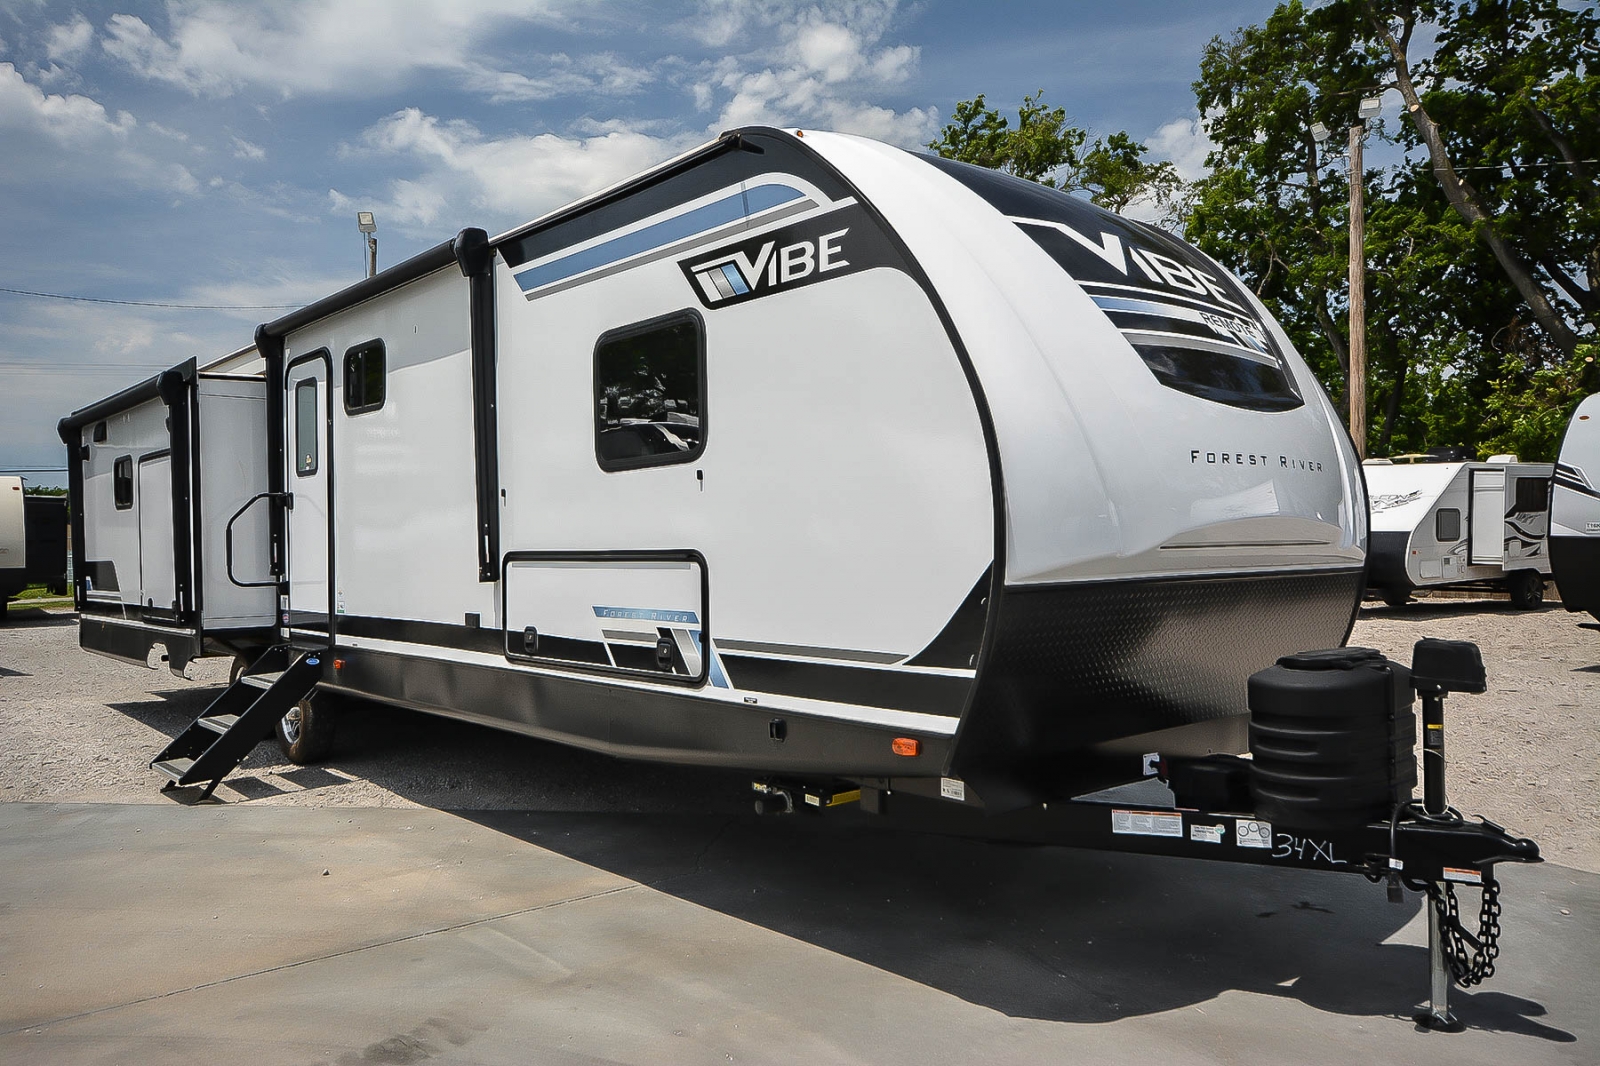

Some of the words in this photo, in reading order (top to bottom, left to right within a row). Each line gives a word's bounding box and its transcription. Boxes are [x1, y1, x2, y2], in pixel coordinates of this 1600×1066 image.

[731, 227, 851, 292] VIBE
[1048, 217, 1251, 314] VIBE
[1199, 311, 1257, 339] REMOTE
[1189, 449, 1268, 467] FOREST
[1279, 455, 1324, 472] RIVER
[602, 609, 645, 619] FOREST
[650, 612, 690, 623] RIVER
[1271, 833, 1348, 864] 34XL
